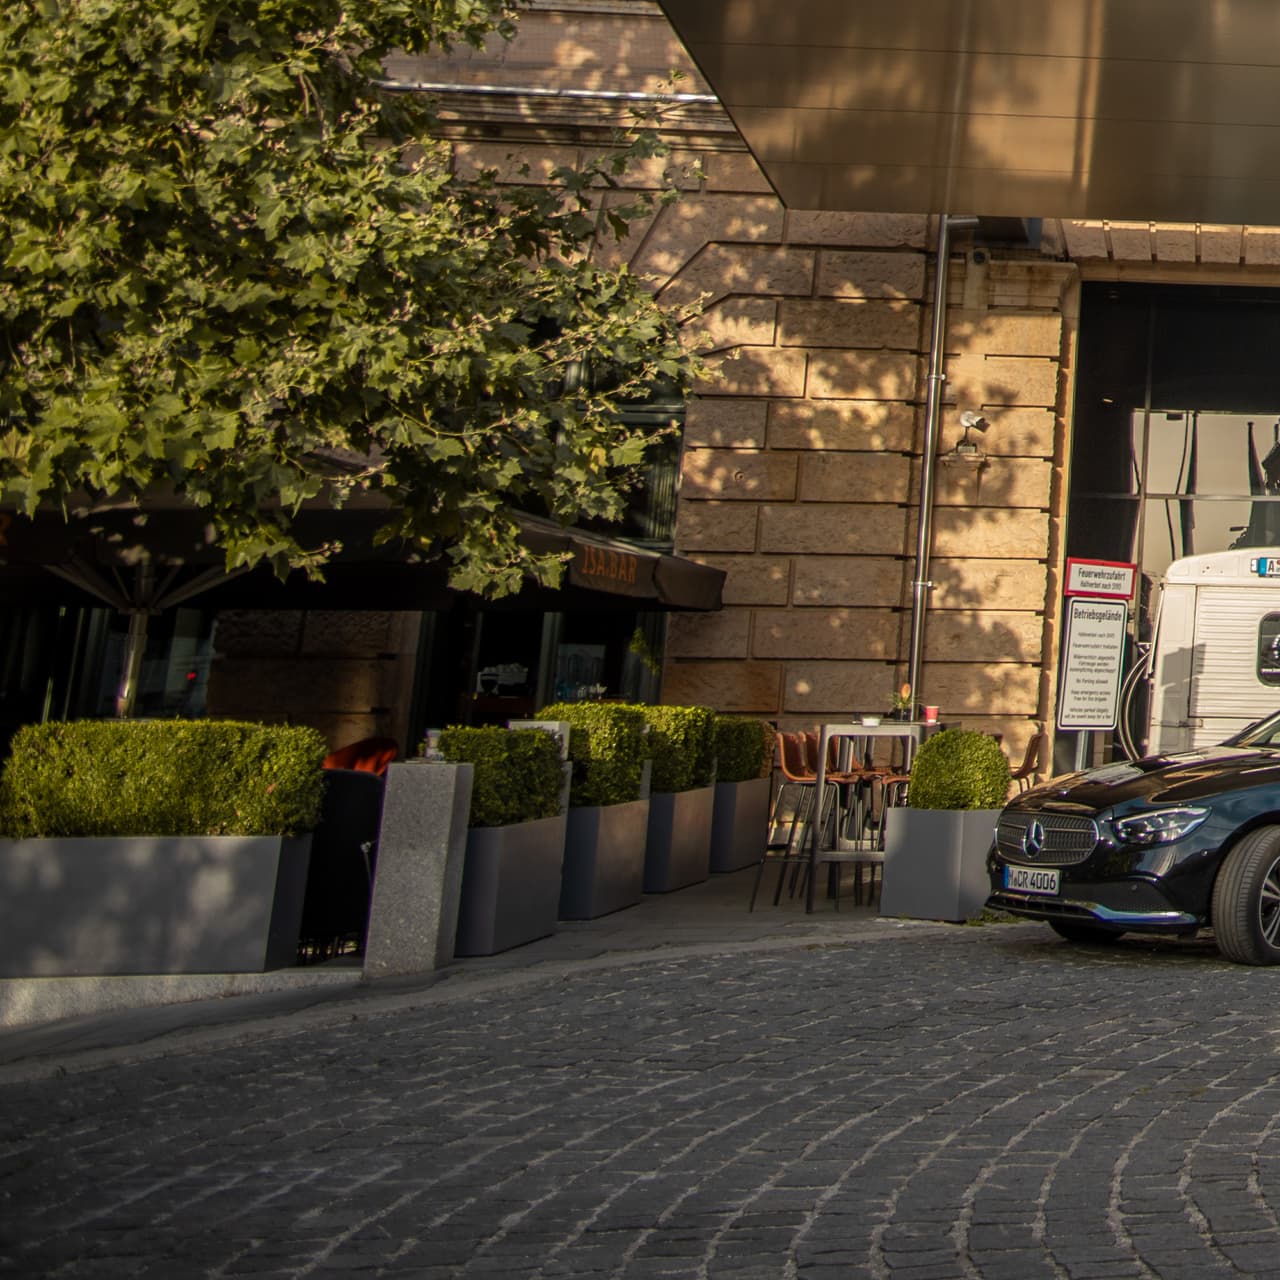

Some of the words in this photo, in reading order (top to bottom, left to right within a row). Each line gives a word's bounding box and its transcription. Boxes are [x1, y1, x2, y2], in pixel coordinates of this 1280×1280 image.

[1267, 559, 1274, 573] A
[1078, 567, 1126, 581] Feuerwehrzufahrt
[1074, 608, 1122, 622] Betriebsgelände
[1030, 872, 1057, 890] 4006
